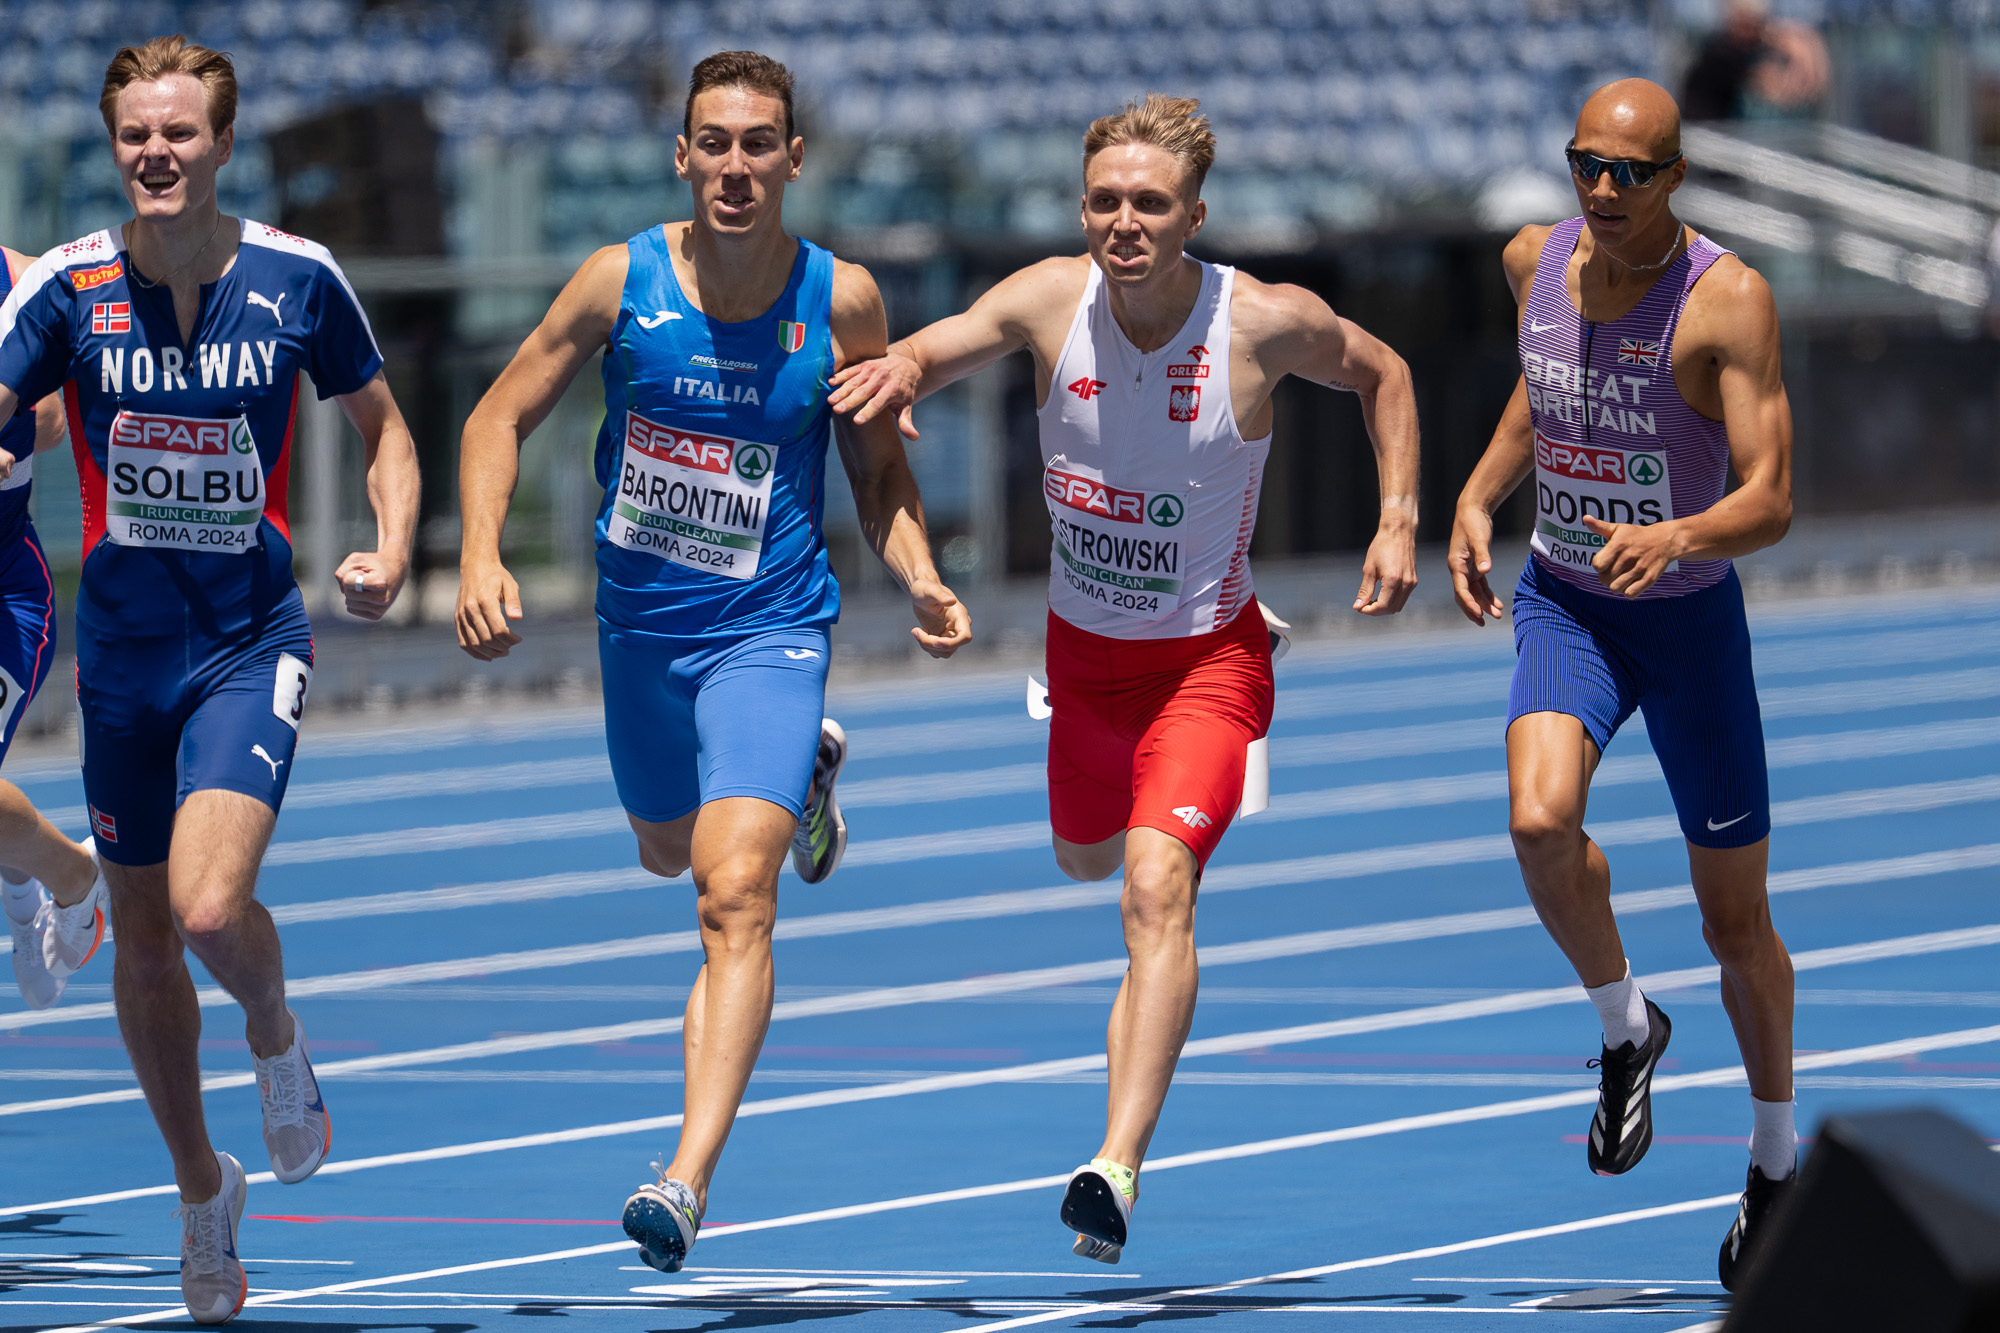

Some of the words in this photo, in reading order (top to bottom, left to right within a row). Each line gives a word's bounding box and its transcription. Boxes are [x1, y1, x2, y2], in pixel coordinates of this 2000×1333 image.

[89, 266, 121, 283] EXTRA
[101, 340, 278, 393] NORWAY
[691, 354, 759, 370] FRECCIAROSSA
[1169, 366, 1208, 377] ORLEN
[1524, 352, 1650, 404] GREAT
[673, 376, 760, 405] ITALIA
[1068, 377, 1107, 400] 4F
[1528, 385, 1657, 435] BRITAIN
[116, 417, 225, 450] SPAR
[629, 420, 731, 469] SPAR
[1537, 440, 1623, 479] SPAR
[113, 462, 259, 503] SOLBU
[620, 462, 761, 530] BARONTINI
[1046, 472, 1142, 519] SPAR
[140, 505, 144, 517] I
[147, 506, 179, 519] RUN
[636, 511, 641, 523] I
[642, 513, 673, 530] RUN
[1539, 480, 1664, 526] DODDS
[129, 522, 192, 543] ROMA
[197, 528, 247, 546] 2024
[624, 526, 681, 557] ROMA
[686, 545, 735, 569] 2024
[1562, 530, 1589, 545] RUN
[1072, 560, 1097, 579] RUN
[1064, 567, 1108, 603] ROMA
[1112, 591, 1159, 613] 2024
[290, 672, 307, 721] 3
[1172, 805, 1213, 828] 4F
